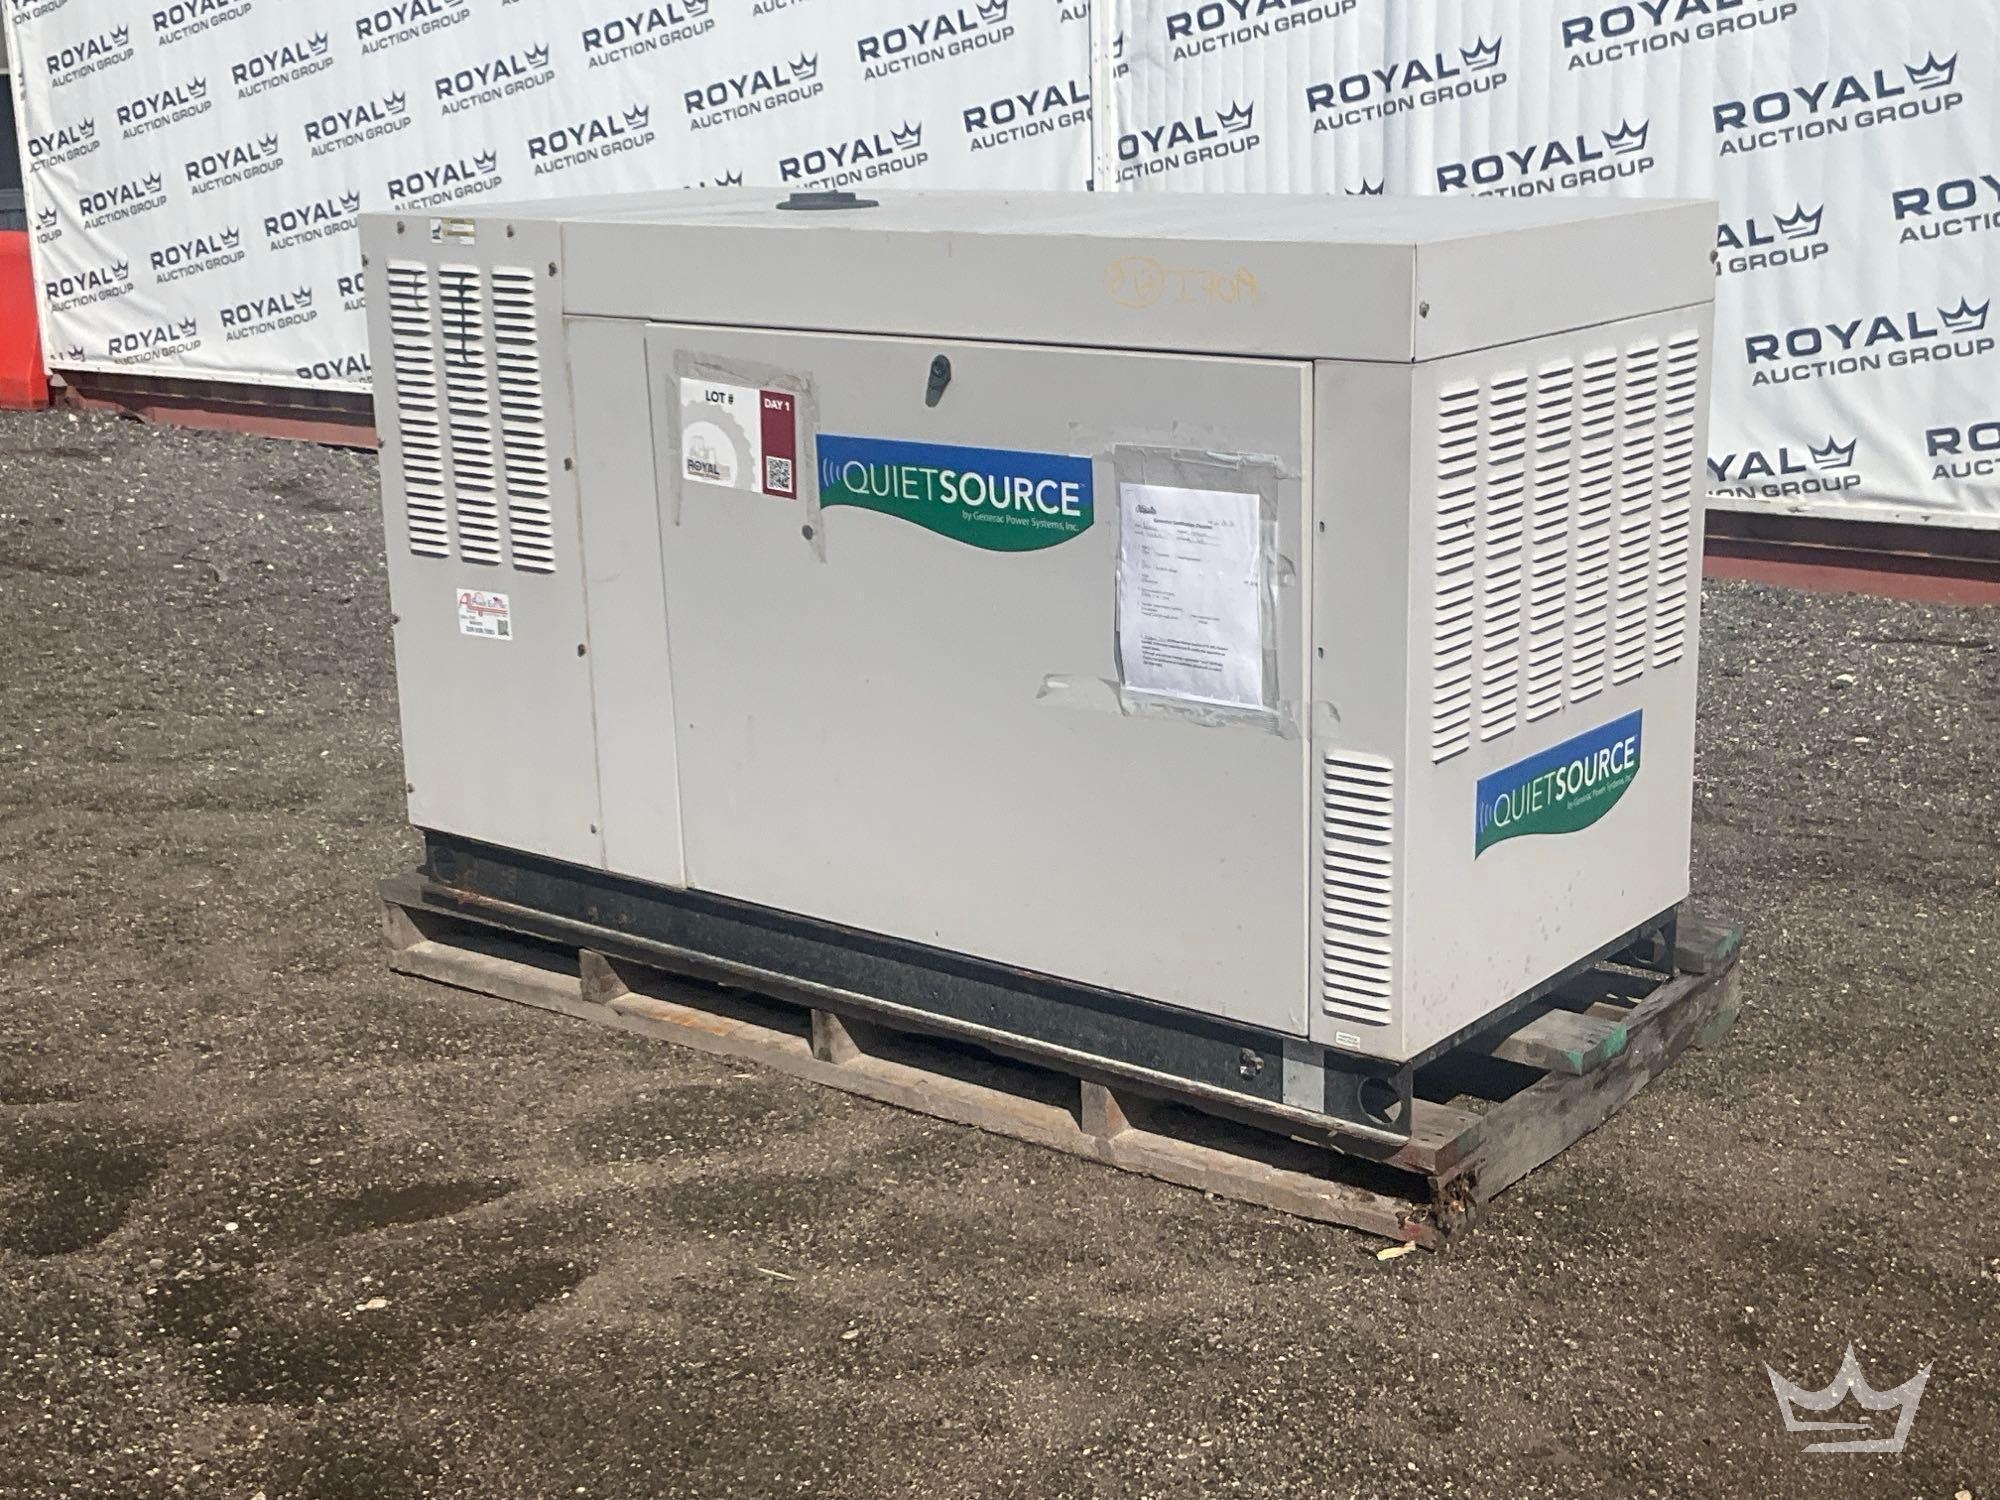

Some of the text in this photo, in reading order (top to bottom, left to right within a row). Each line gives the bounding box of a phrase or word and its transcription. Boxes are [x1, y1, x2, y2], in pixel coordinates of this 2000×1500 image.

[159, 3, 252, 46] AUCTION GROUP
[361, 8, 471, 56] AUCTION GROUP
[582, 3, 684, 51] ROYAL
[588, 19, 715, 69] AUCTION GROUP
[857, 9, 979, 62] ROYAL
[1173, 0, 1357, 62] AUCTION GROUP
[1568, 2, 1798, 71] AUCTION GROUP
[46, 35, 113, 74] ROYAL
[52, 48, 134, 88] AUCTION GROUP
[232, 43, 310, 84] ROYAL
[864, 26, 1015, 81] AUCTION GROUP
[238, 57, 334, 100] AUCTION GROUP
[435, 55, 527, 100] ROYAL
[441, 70, 556, 116] AUCTION GROUP
[683, 65, 791, 114] ROYAL
[1305, 52, 1461, 113] ROYAL
[117, 86, 189, 126] ROYAL
[122, 100, 213, 140] AUCTION GROUP
[304, 99, 386, 142] ROYAL
[690, 82, 824, 131] AUCTION GROUP
[963, 80, 1090, 132] ROYAL
[1313, 72, 1508, 134] AUCTION GROUP
[1712, 69, 1905, 134] ROYAL
[311, 116, 412, 158] AUCTION GROUP
[527, 113, 624, 160] ROYAL
[970, 118, 1054, 151] AUCTION
[1719, 91, 1964, 158] AUCTION GROUP
[66, 140, 100, 162] GROUP
[185, 143, 261, 182] ROYAL
[534, 131, 656, 176] AUCTION GROUP
[779, 134, 893, 182] ROYAL
[865, 152, 928, 179] GROUP
[1184, 134, 1260, 165] GROUP
[1436, 136, 1603, 192] ROYAL
[191, 157, 284, 196] AUCTION GROUP
[387, 159, 475, 200] ROYAL
[454, 175, 503, 199] GROUP
[1560, 156, 1655, 189] GROUP
[79, 181, 146, 217] ROYAL
[84, 195, 167, 230] AUCTION GROUP
[264, 199, 342, 237] ROYAL
[150, 234, 222, 271] ROYAL
[270, 228, 323, 251] AUCTION
[1729, 242, 1829, 273] GROUP
[45, 268, 113, 300] ROYAL
[156, 250, 246, 285] AUCTION GROUP
[51, 282, 134, 313] AUCTION GROUP
[220, 294, 295, 328] ROYAL
[108, 324, 180, 355] ROYAL
[226, 310, 318, 342] AUCTION GROUP
[1744, 312, 1938, 365] ROYAL
[161, 339, 201, 357] GROUP
[1751, 337, 1996, 387] AUCTION GROUP
[705, 390, 726, 403] LOT
[764, 398, 790, 411] DAY 1
[688, 459, 720, 475] ROYAL
[1761, 474, 1861, 498] GROUP
[973, 511, 1004, 524] Generac
[1006, 514, 1030, 527] Power
